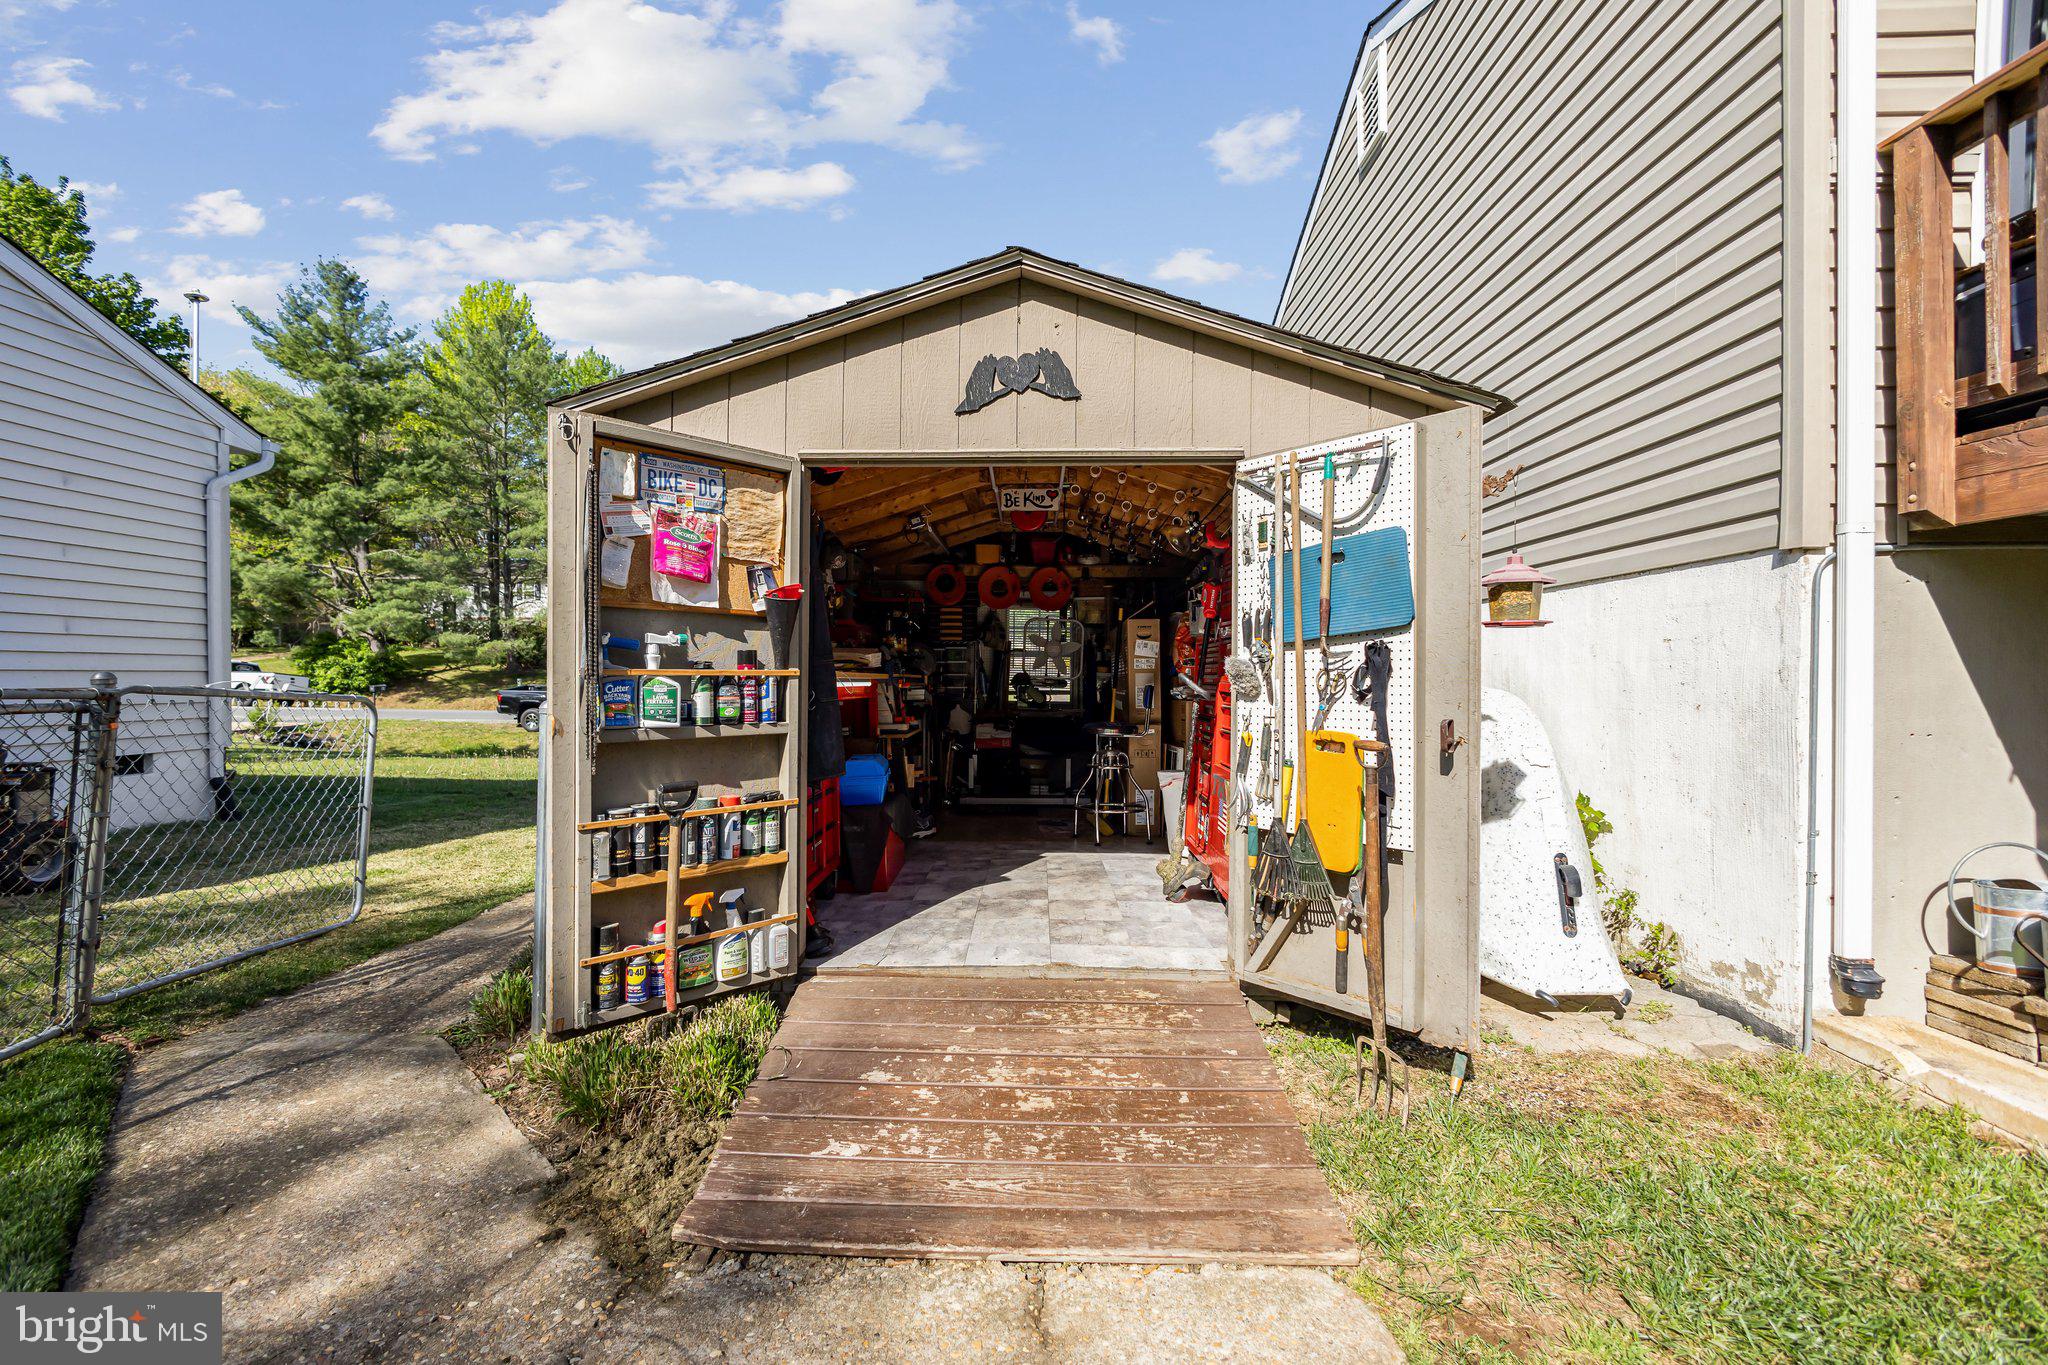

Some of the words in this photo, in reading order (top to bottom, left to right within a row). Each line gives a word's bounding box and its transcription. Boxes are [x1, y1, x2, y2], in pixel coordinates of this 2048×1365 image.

[647, 468, 683, 493] BIKE
[698, 477, 718, 498] DC
[675, 528, 698, 540] Scotts
[663, 538, 681, 547] Rose
[605, 685, 630, 694] Cutter
[628, 968, 645, 977] D-40
